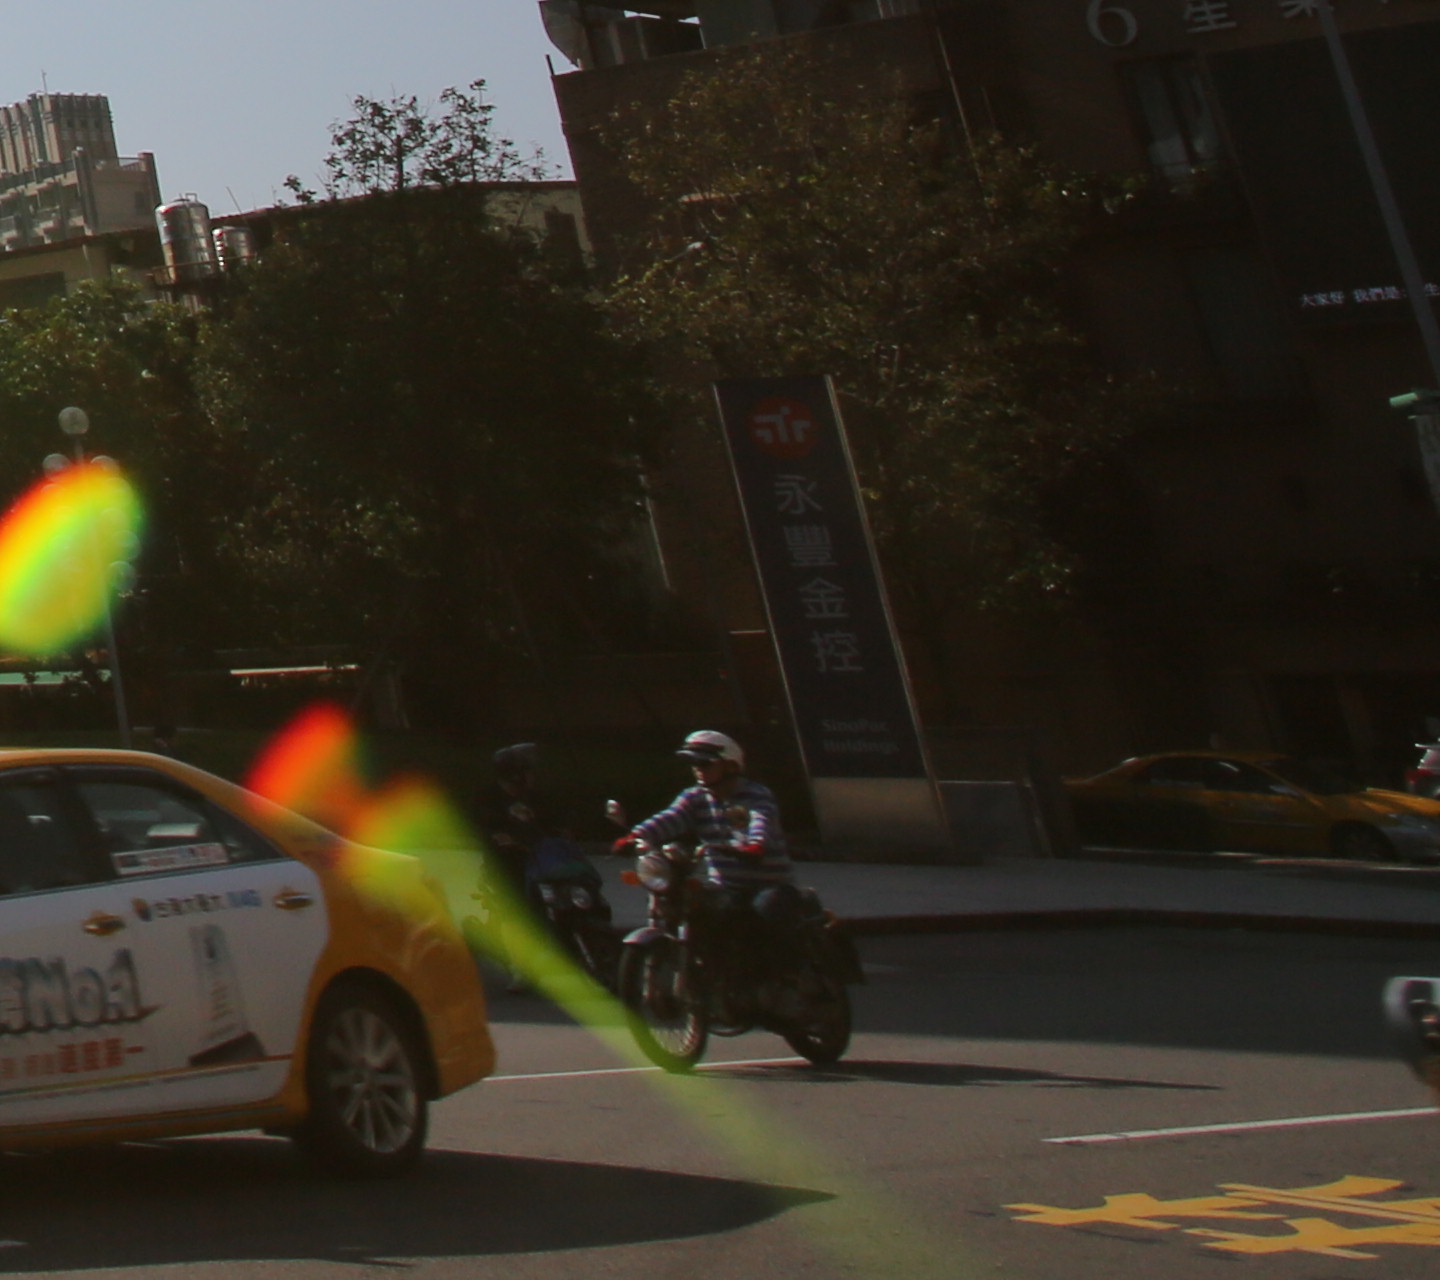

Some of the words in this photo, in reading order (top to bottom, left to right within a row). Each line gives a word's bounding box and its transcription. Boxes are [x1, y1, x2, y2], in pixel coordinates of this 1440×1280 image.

[774, 472, 864, 674] 永豐金控
[821, 718, 890, 734] SinoPac
[822, 739, 900, 756] Holdings
